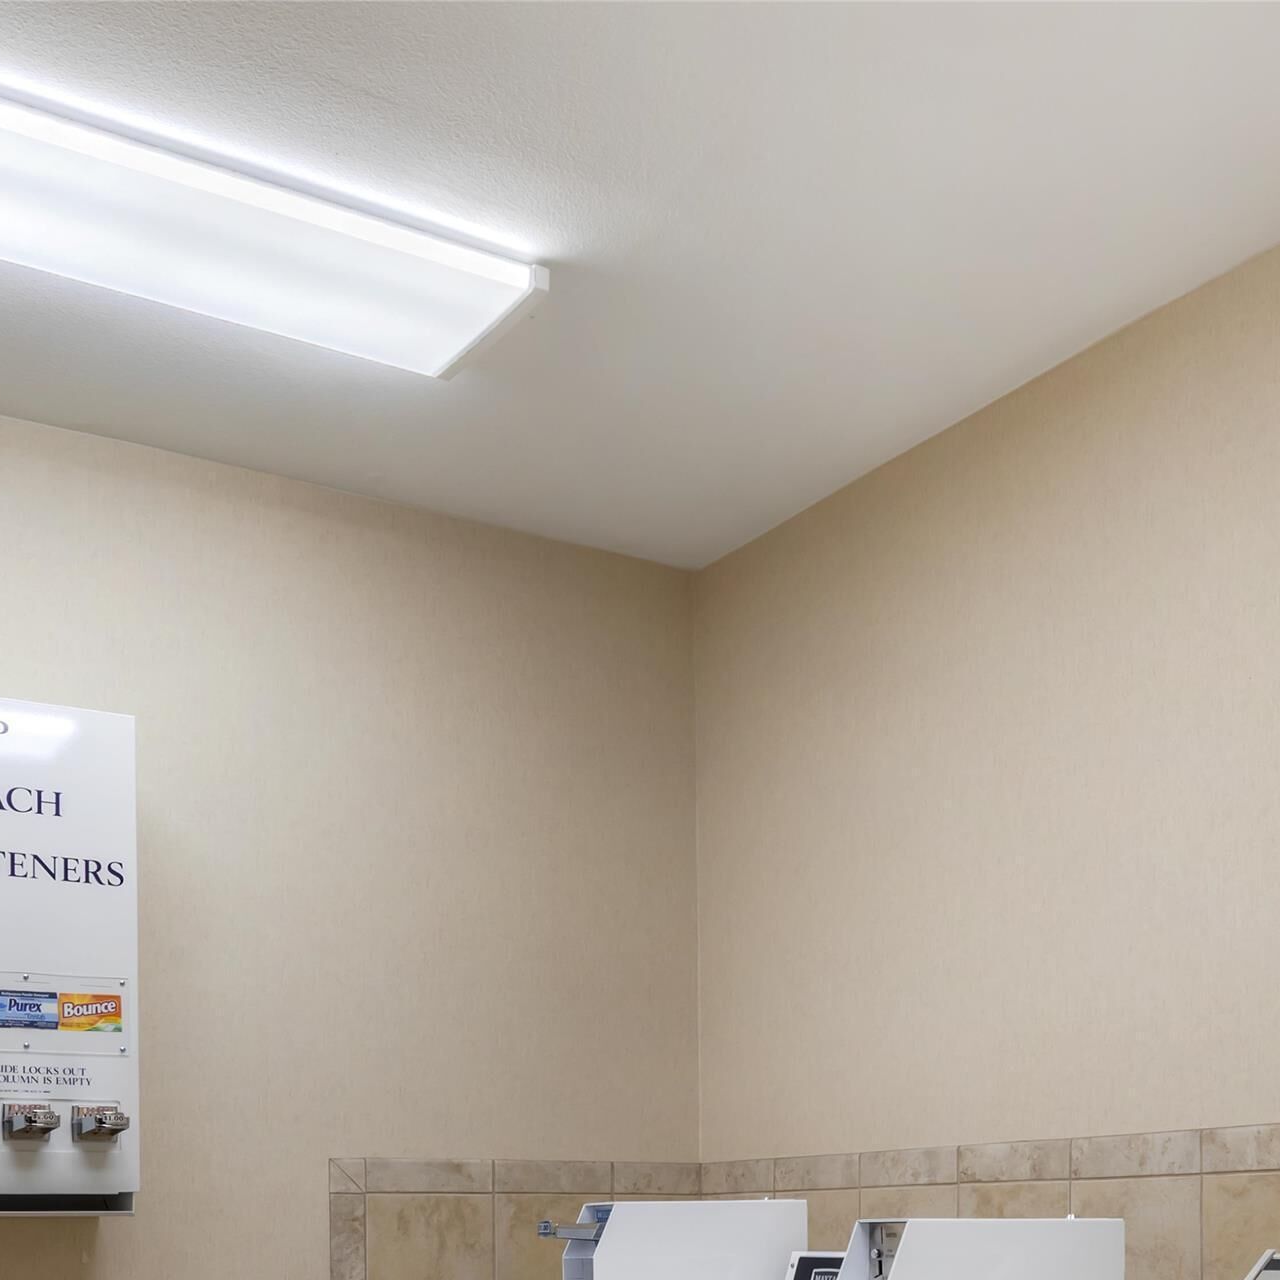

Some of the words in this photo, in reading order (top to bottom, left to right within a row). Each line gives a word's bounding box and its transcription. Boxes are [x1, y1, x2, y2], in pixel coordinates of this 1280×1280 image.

[8, 998, 42, 1013] Purex
[63, 1000, 117, 1017] Bounce
[22, 1065, 59, 1075] LOCKS
[62, 1067, 87, 1076] OUT
[43, 1076, 52, 1085] IS
[56, 1077, 92, 1086] EMPTY
